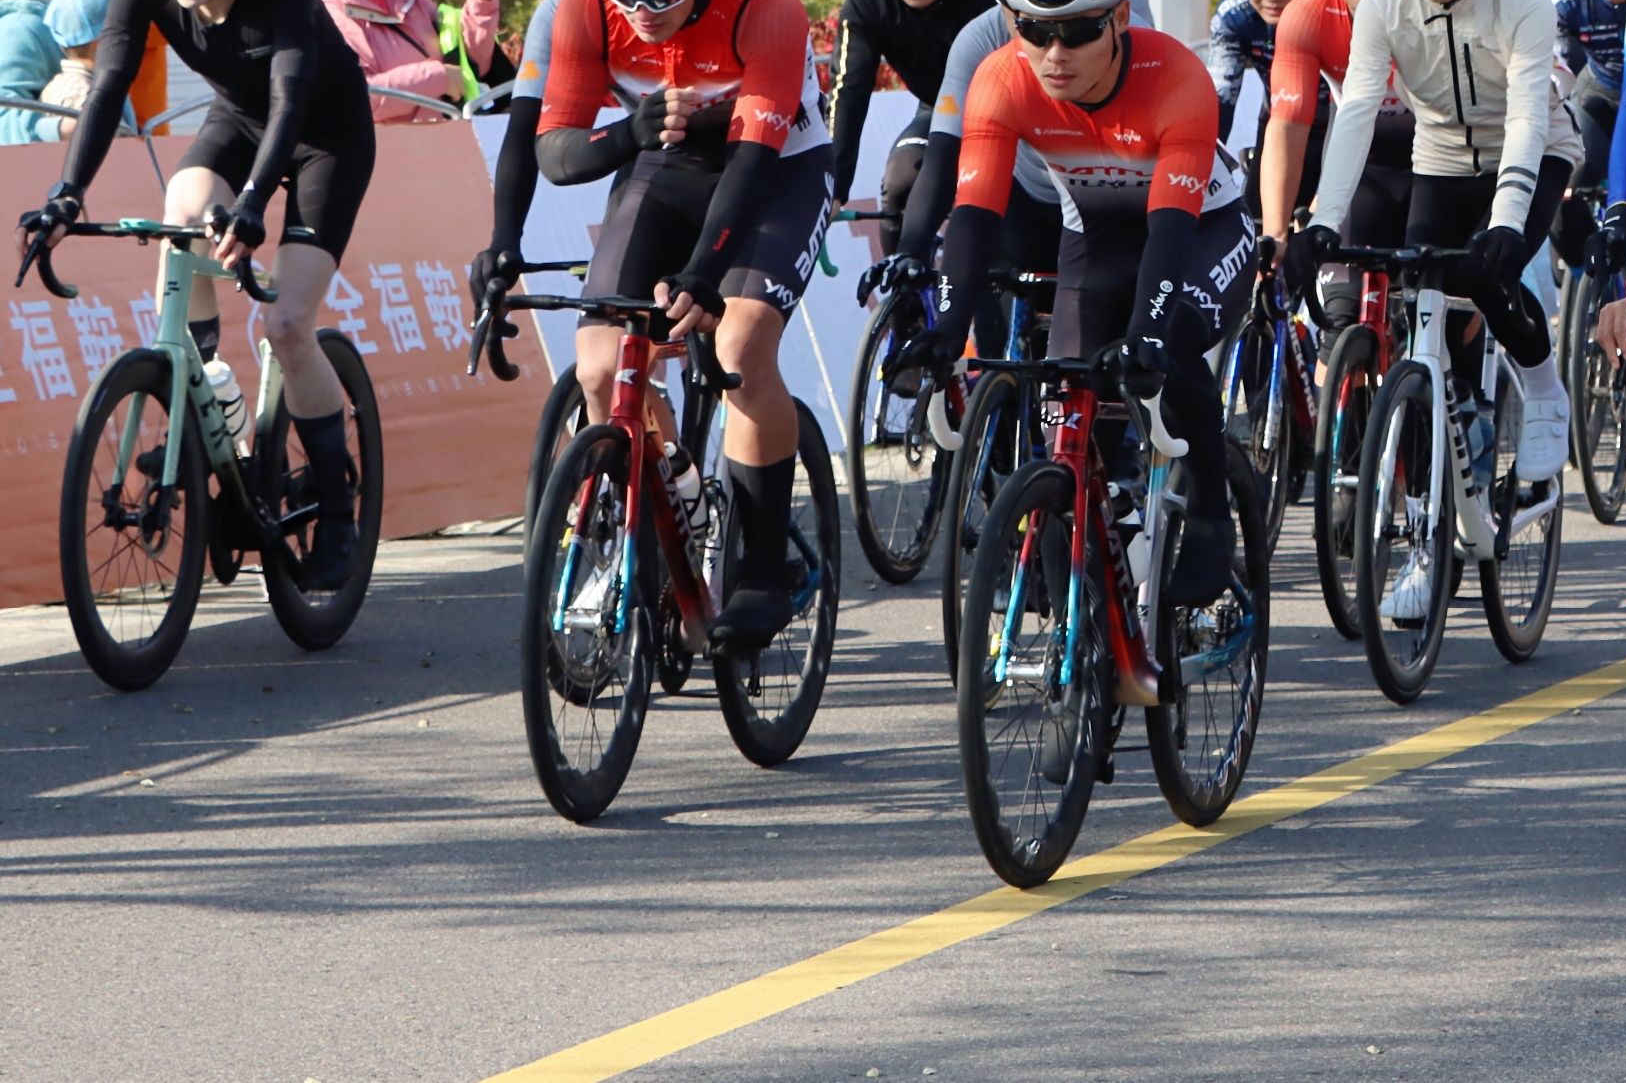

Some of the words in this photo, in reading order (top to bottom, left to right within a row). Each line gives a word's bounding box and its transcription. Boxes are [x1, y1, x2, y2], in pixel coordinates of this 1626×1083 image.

[0, 289, 161, 405] 福鞍
[323, 258, 522, 356] 全福鞍
